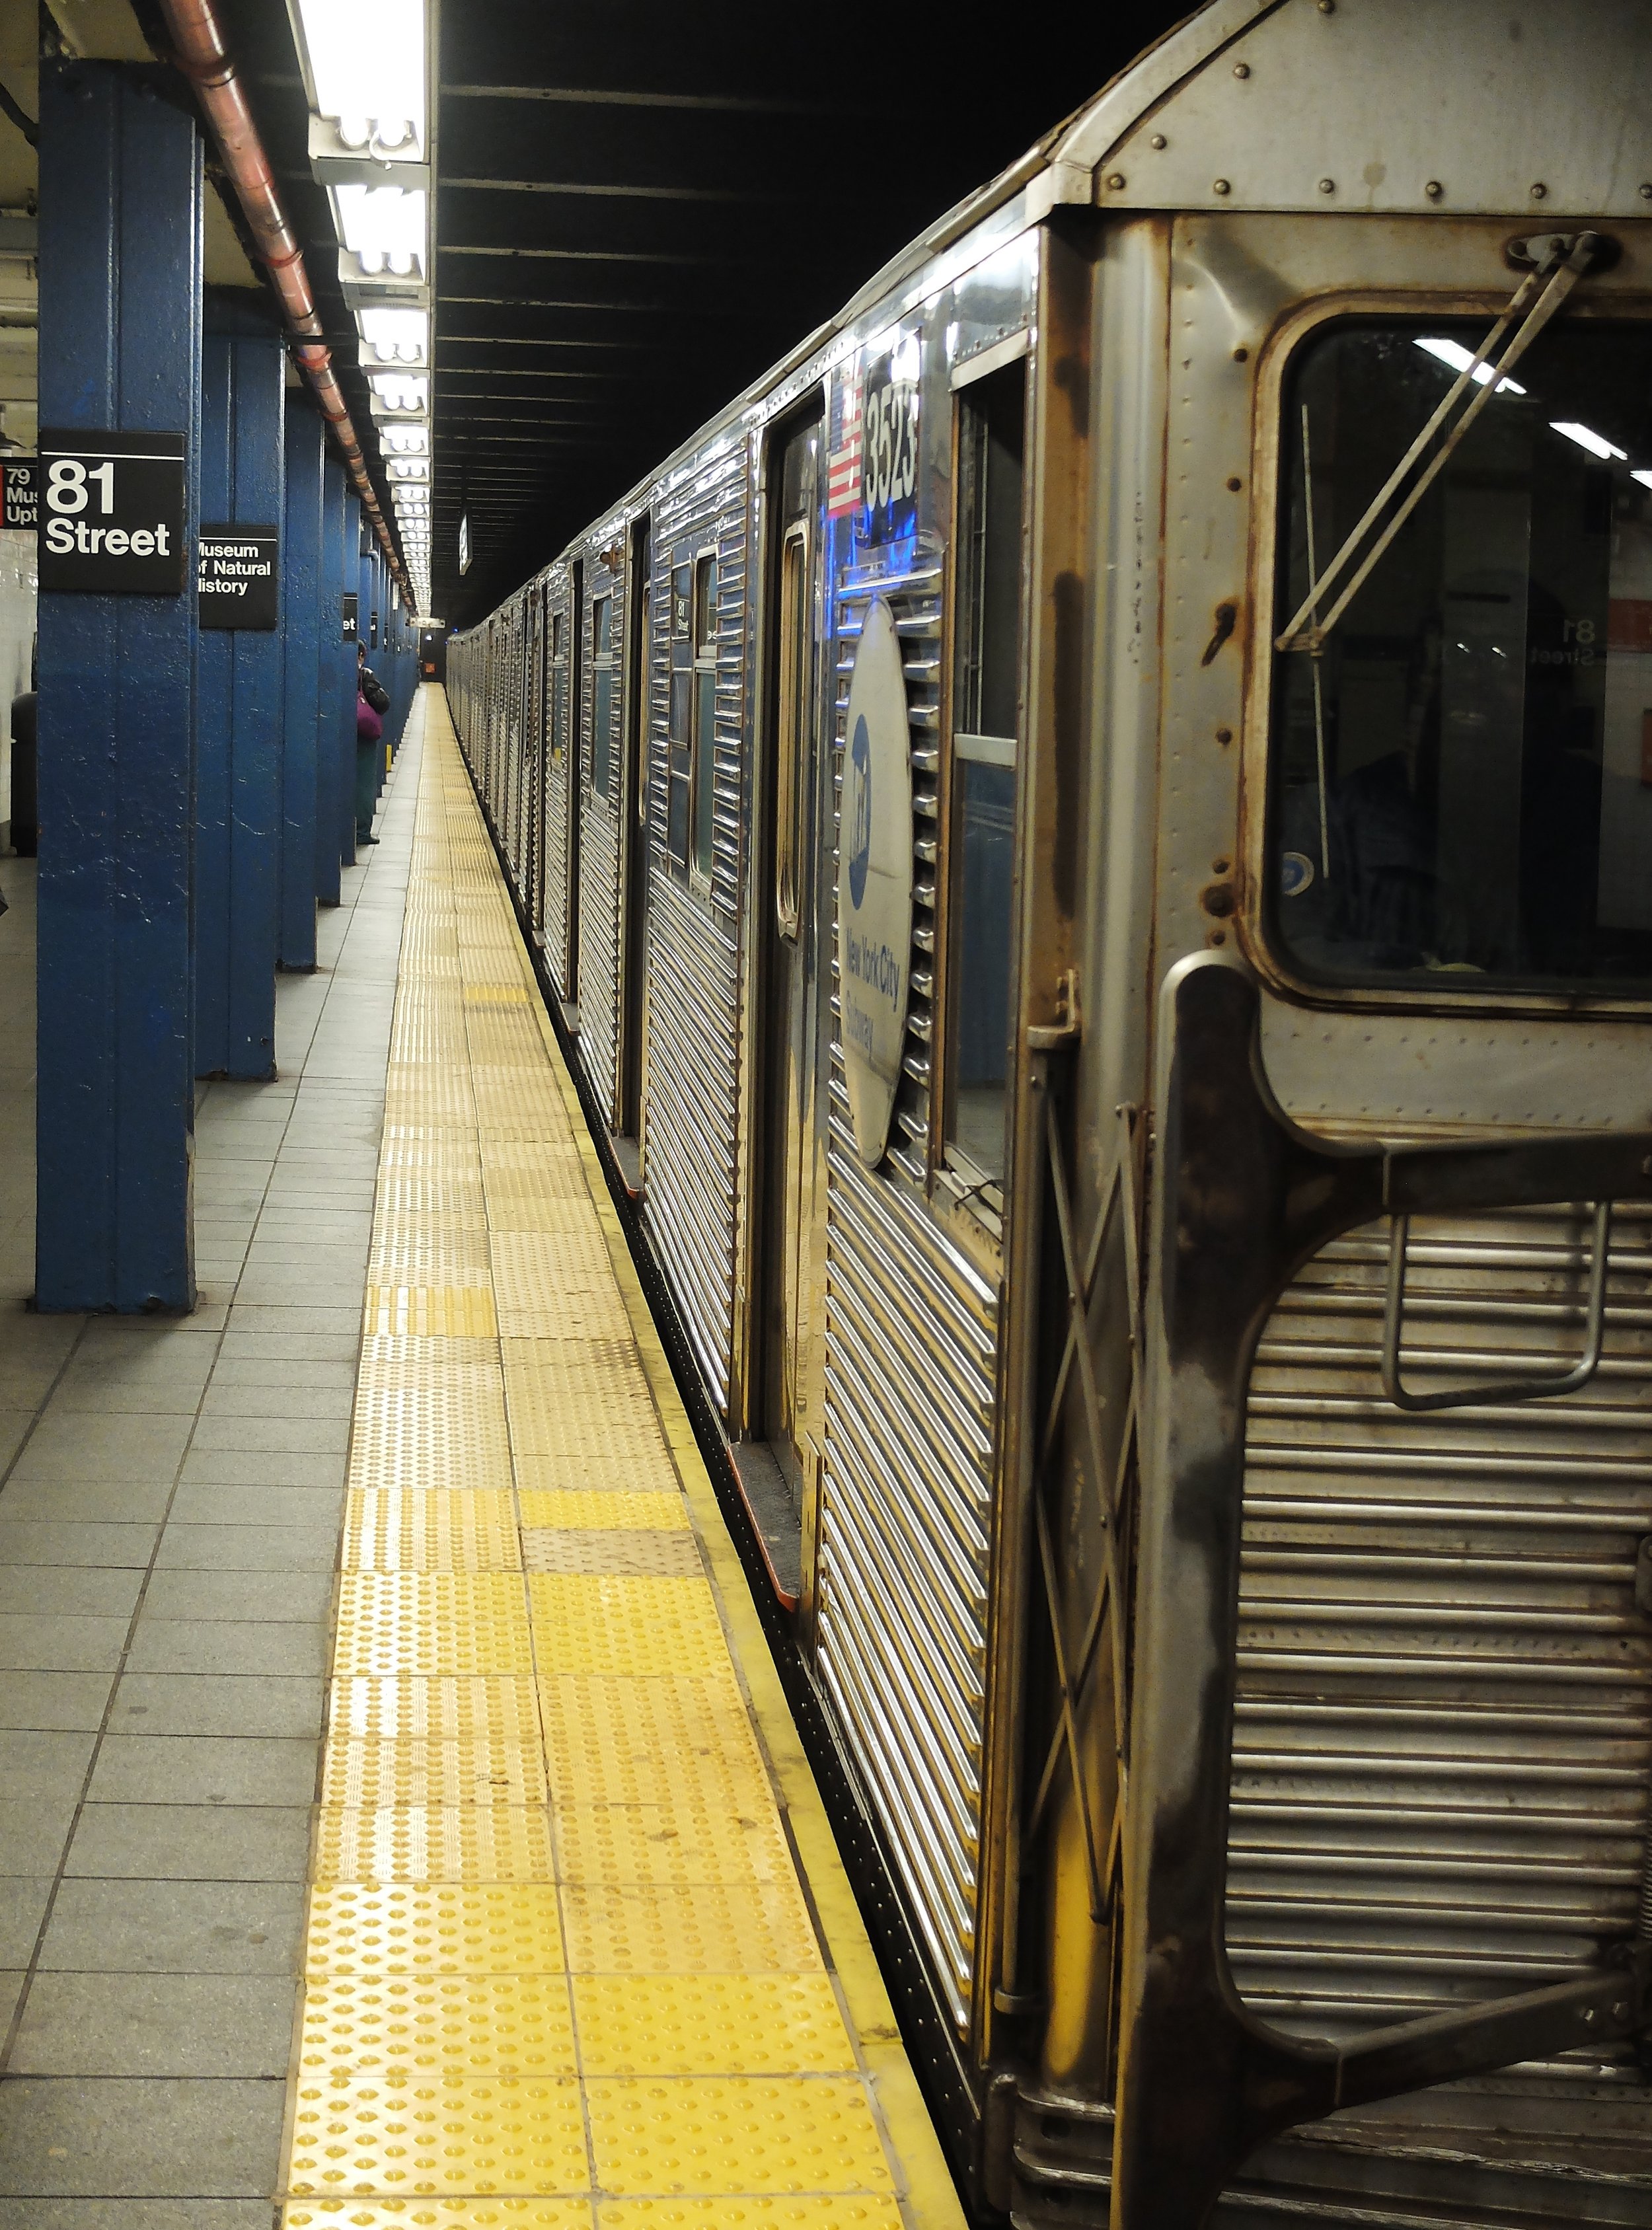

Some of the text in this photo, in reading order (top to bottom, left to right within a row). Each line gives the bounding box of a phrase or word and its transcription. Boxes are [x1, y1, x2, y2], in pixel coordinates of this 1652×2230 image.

[866, 379, 918, 512] 3523
[7, 468, 30, 485] 79
[47, 460, 114, 513] 81
[46, 517, 170, 556] Street
[213, 560, 271, 576] Natural
[861, 934, 880, 991] York
[880, 944, 900, 1013] City
